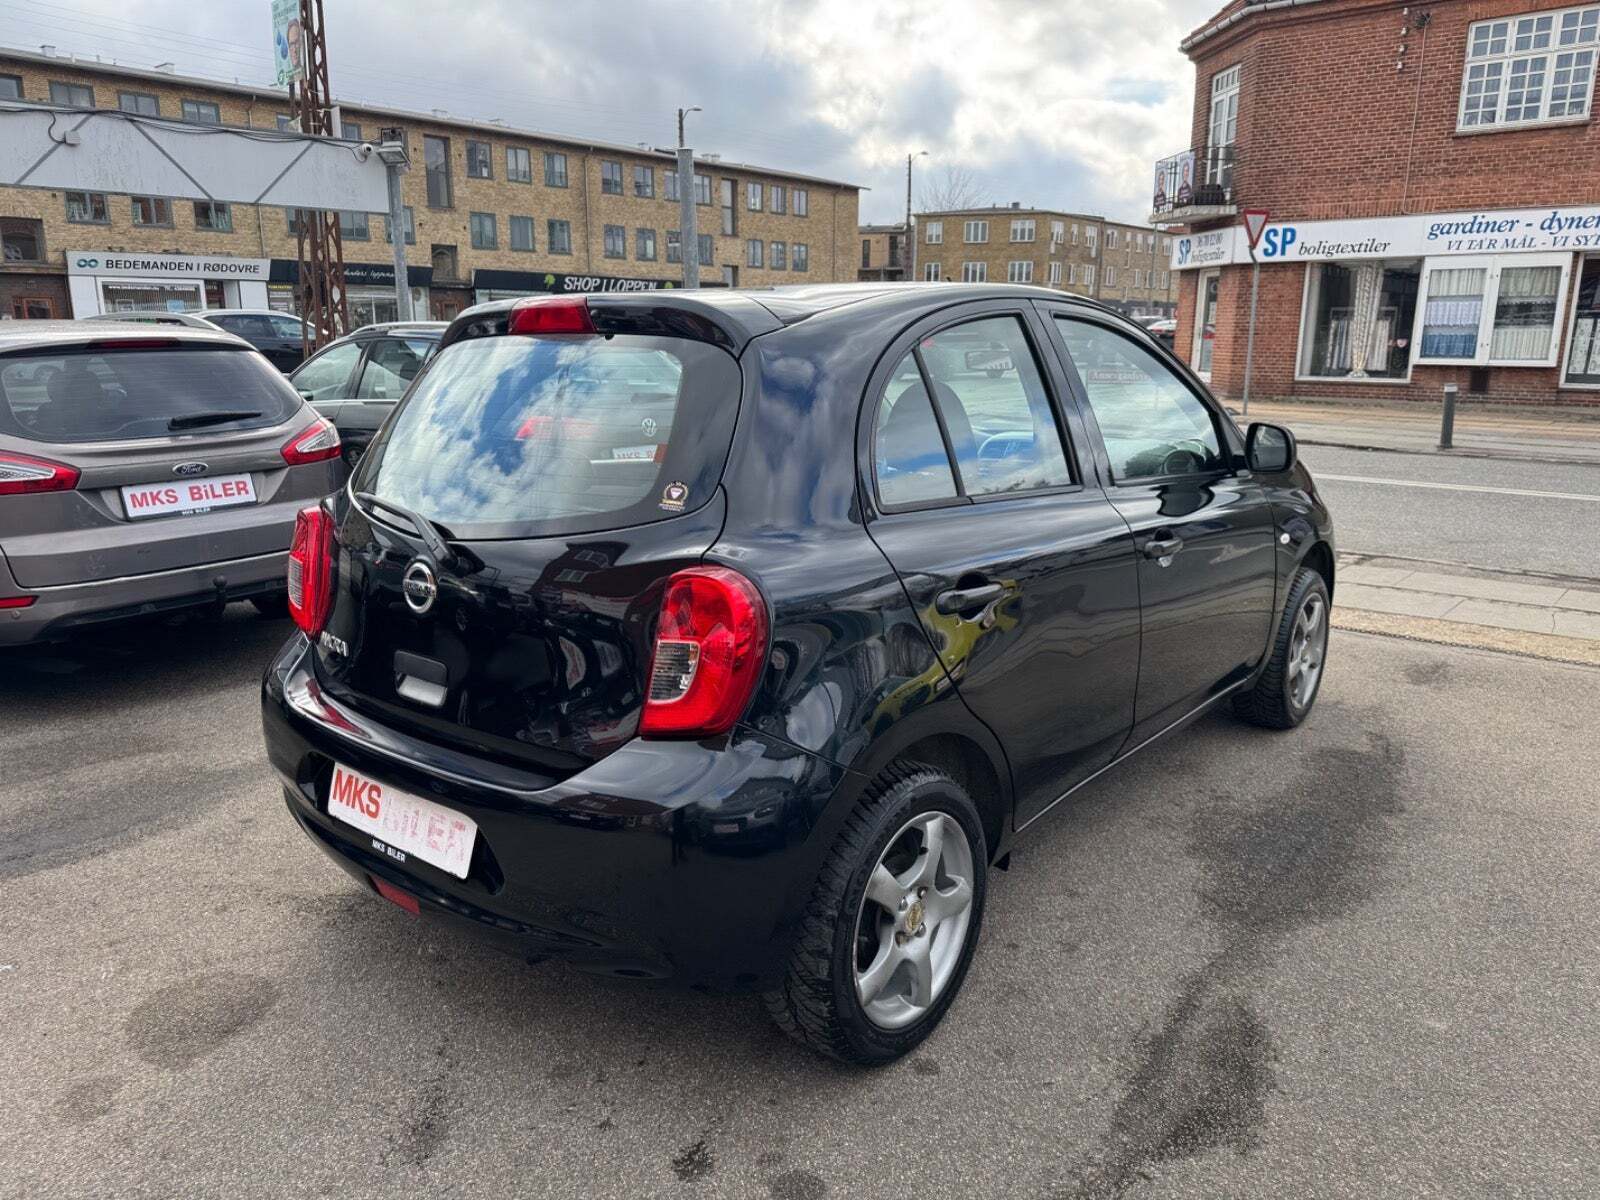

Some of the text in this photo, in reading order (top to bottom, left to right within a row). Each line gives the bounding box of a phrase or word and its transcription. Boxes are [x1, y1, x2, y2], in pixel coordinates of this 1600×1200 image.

[1427, 215, 1520, 240] gardiner
[1178, 239, 1191, 265] SP
[1263, 227, 1391, 257] SP boligtextiler
[1447, 239, 1463, 251] VI
[1500, 234, 1537, 249] MÅL
[1551, 235, 1570, 248] VI
[106, 259, 193, 272] BEDEMANDEN
[203, 262, 260, 274] RØDOVRE
[564, 276, 600, 291] SHOP
[608, 279, 658, 292] LOPPEN
[180, 463, 203, 475] Ford
[130, 480, 250, 509] MKS BiLER
[332, 768, 382, 820] MKS
[371, 838, 385, 853] MKS
